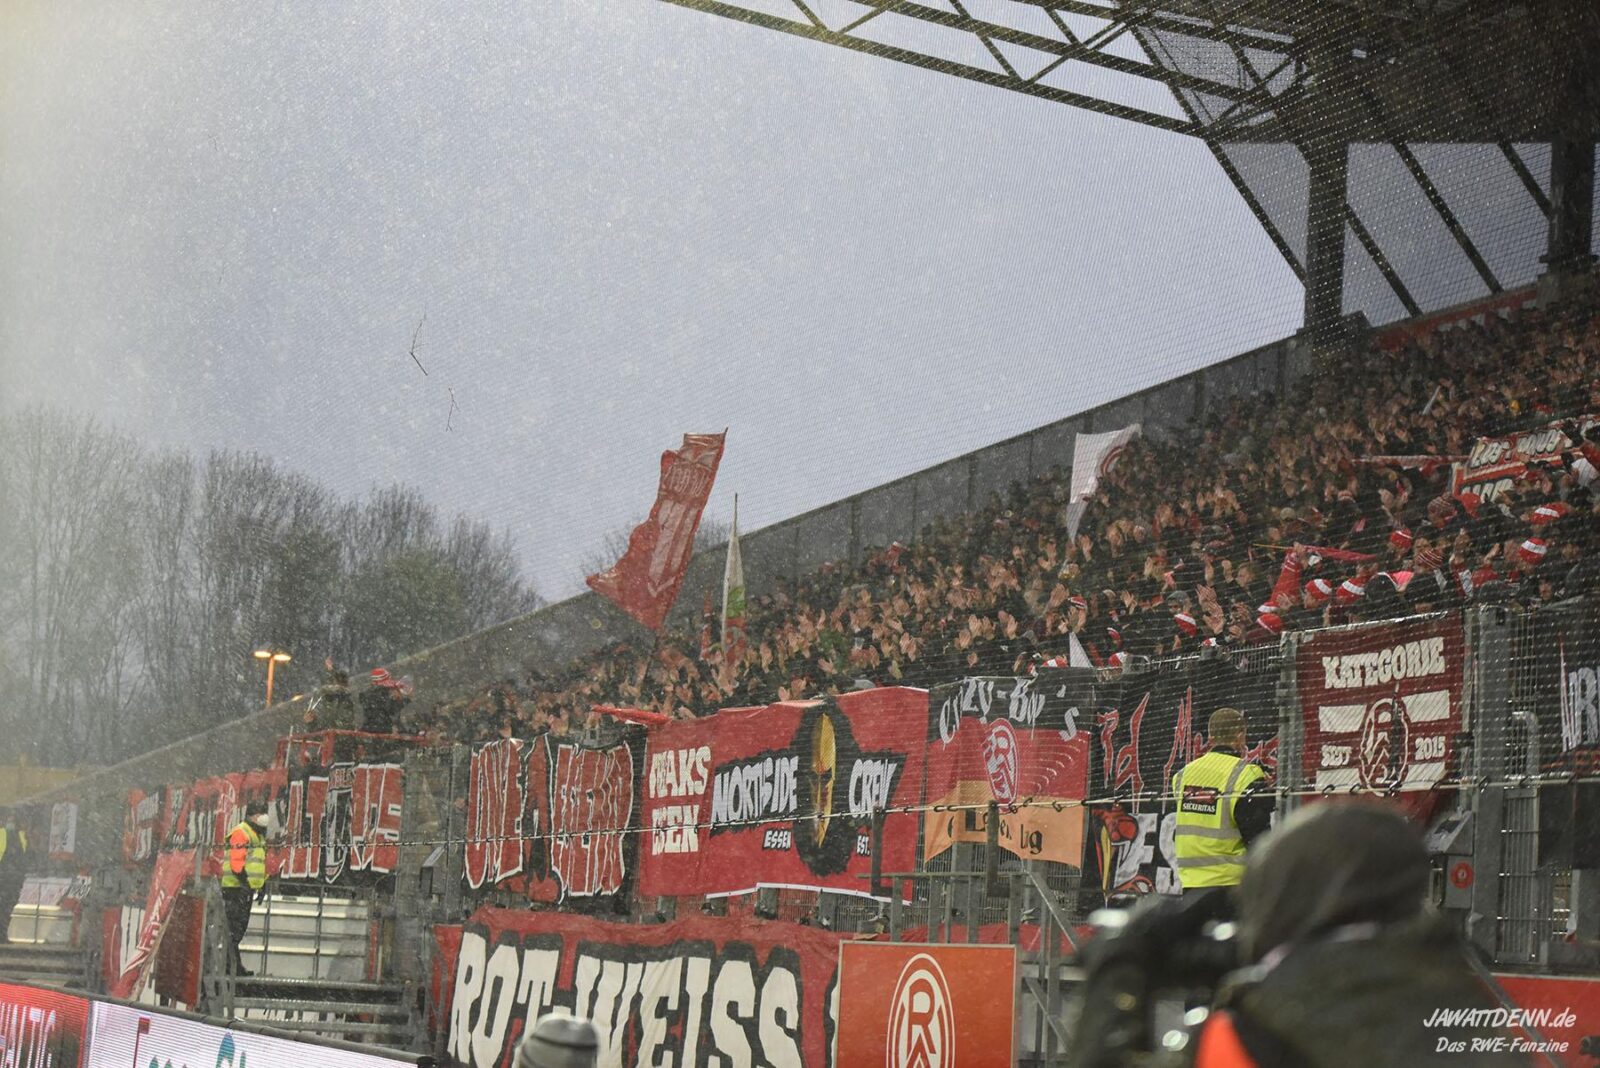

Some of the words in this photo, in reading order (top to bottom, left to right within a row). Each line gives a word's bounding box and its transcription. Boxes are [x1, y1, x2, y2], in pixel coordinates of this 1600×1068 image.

[1322, 636, 1446, 688] KATEGORIE
[1415, 735, 1446, 760] 2015
[711, 755, 800, 828] NORTHSIDE
[848, 758, 898, 818] CREW
[1182, 801, 1216, 813] SECURITAS
[763, 830, 792, 849] ESSEN
[446, 931, 804, 1068] ROT-WEISS
